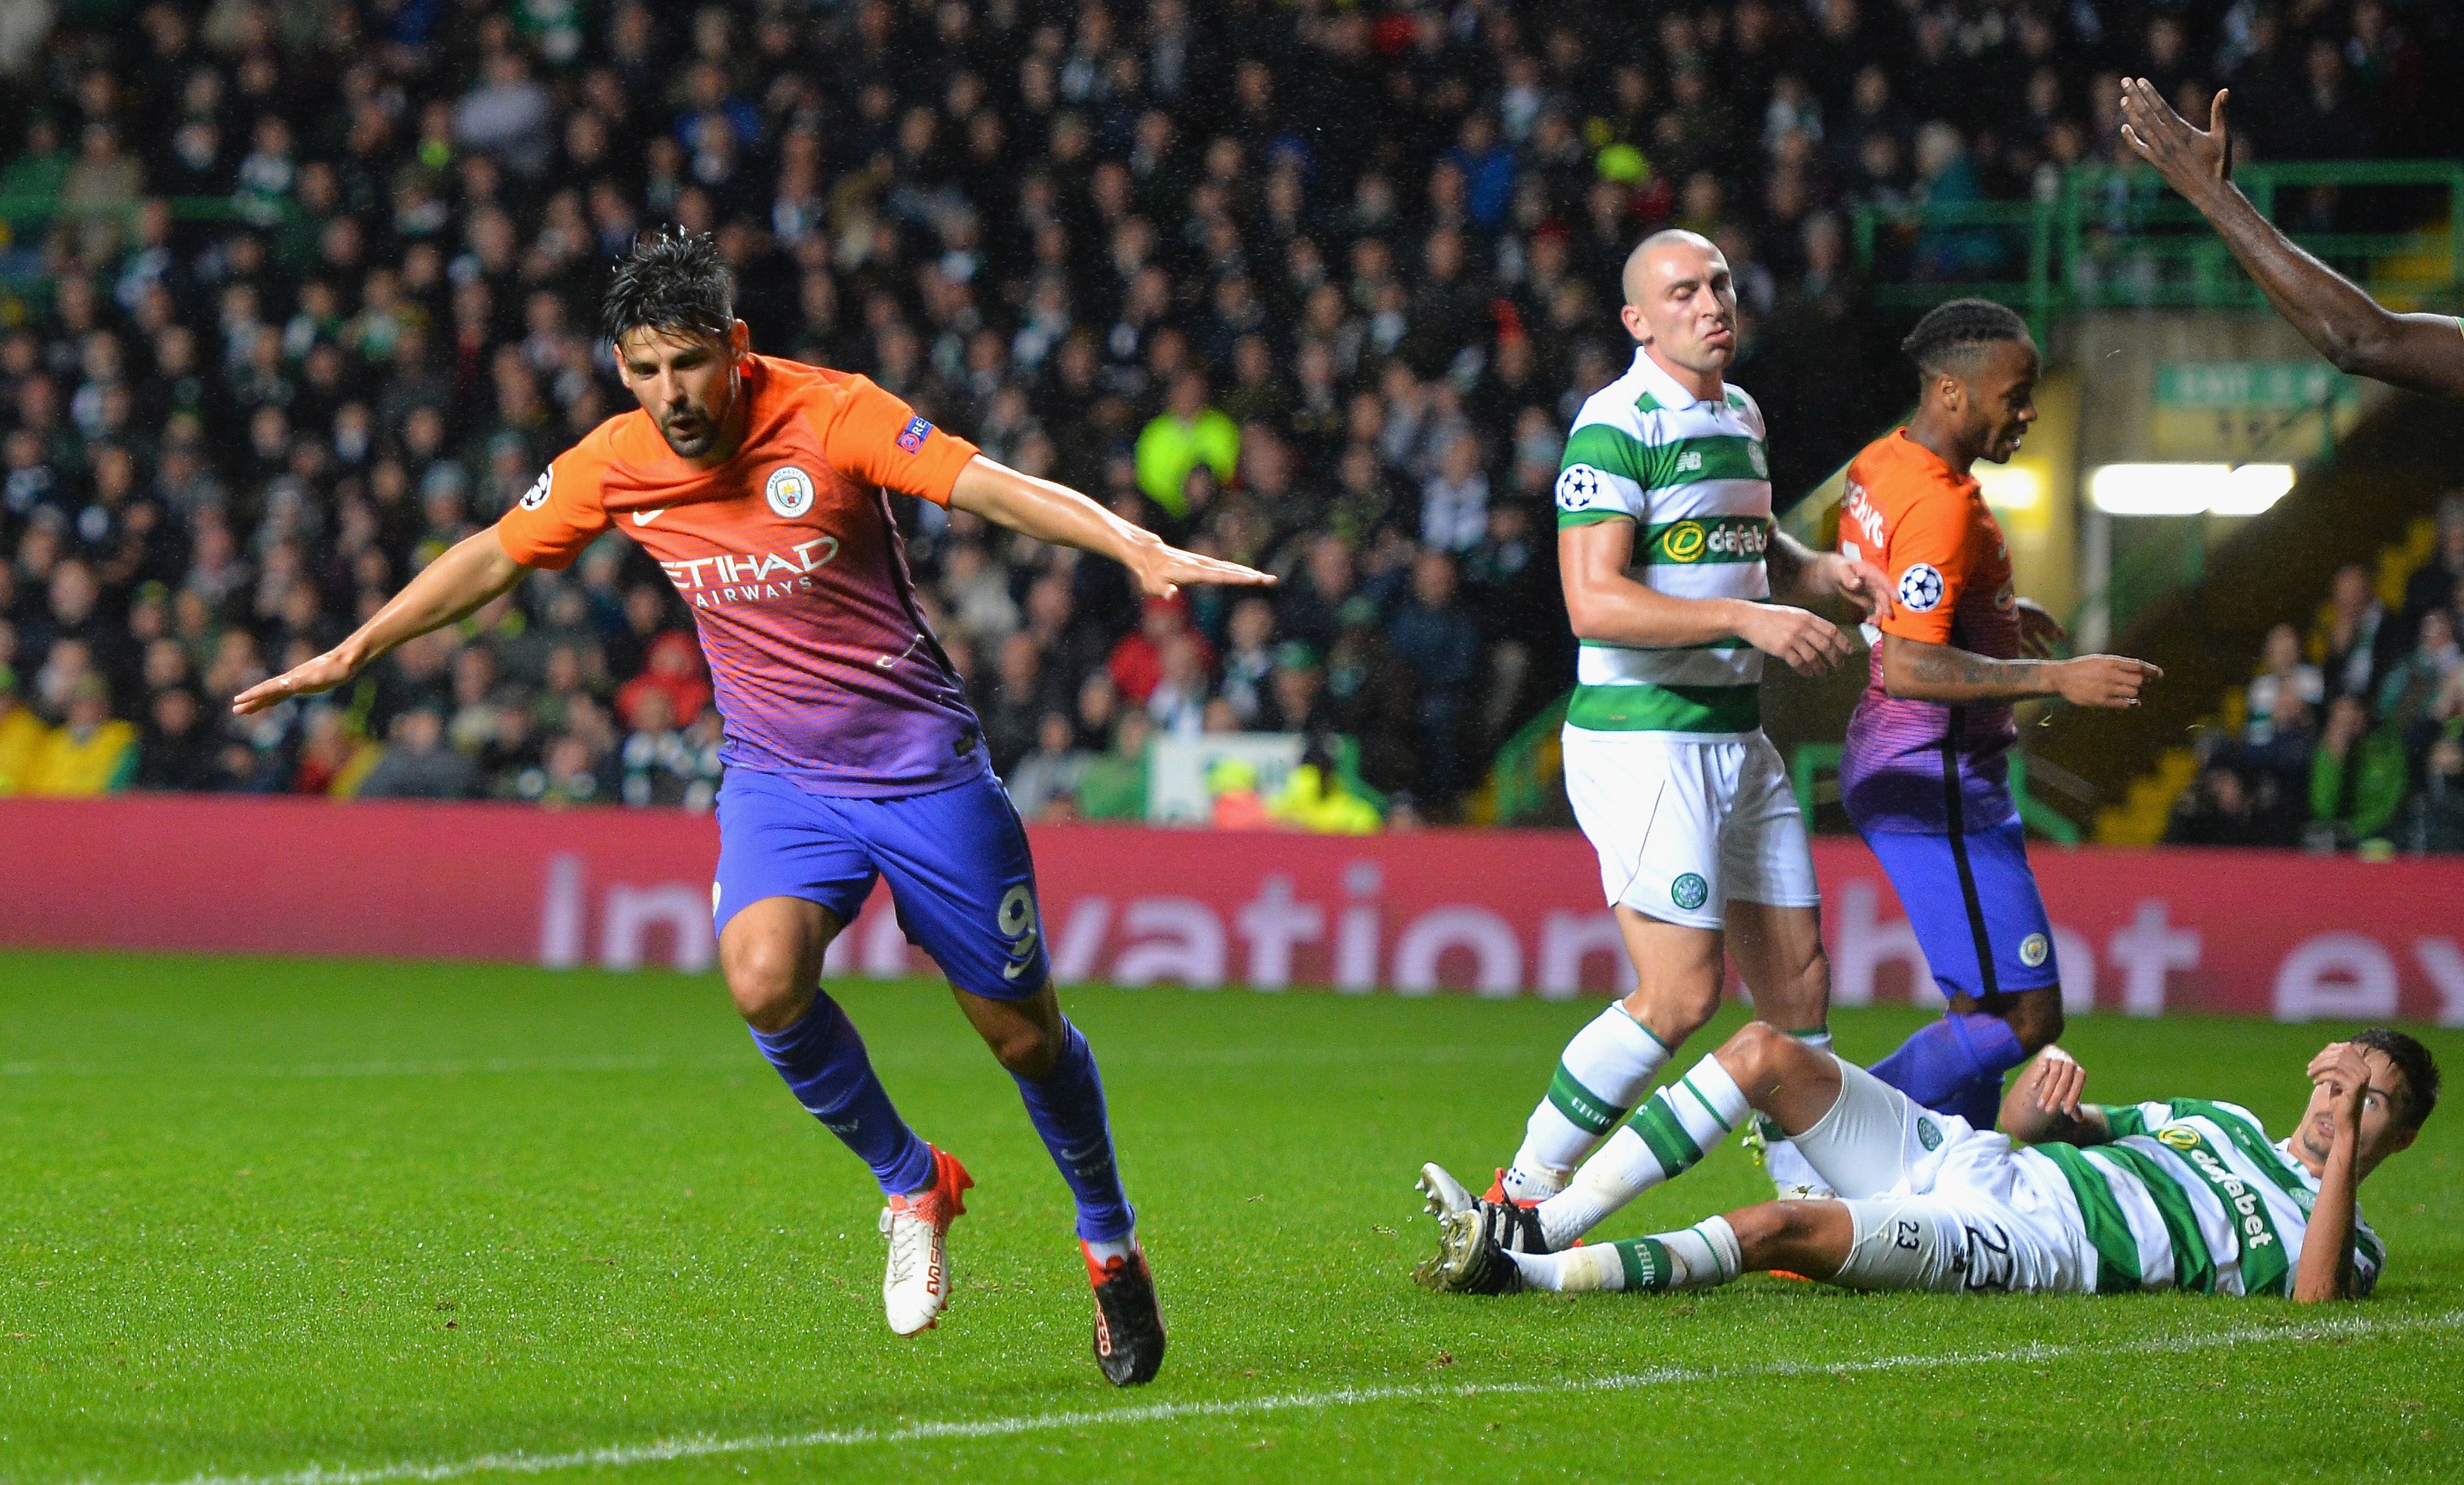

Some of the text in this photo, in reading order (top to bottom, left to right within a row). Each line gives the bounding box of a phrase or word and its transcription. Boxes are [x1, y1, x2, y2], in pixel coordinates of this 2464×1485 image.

[659, 536, 839, 588] ETIHAD
[695, 576, 813, 608] AIRWAYS
[998, 884, 1036, 957] 9
[1898, 1221, 1919, 1249] 23
[1634, 1243, 1656, 1287] CELTIC
